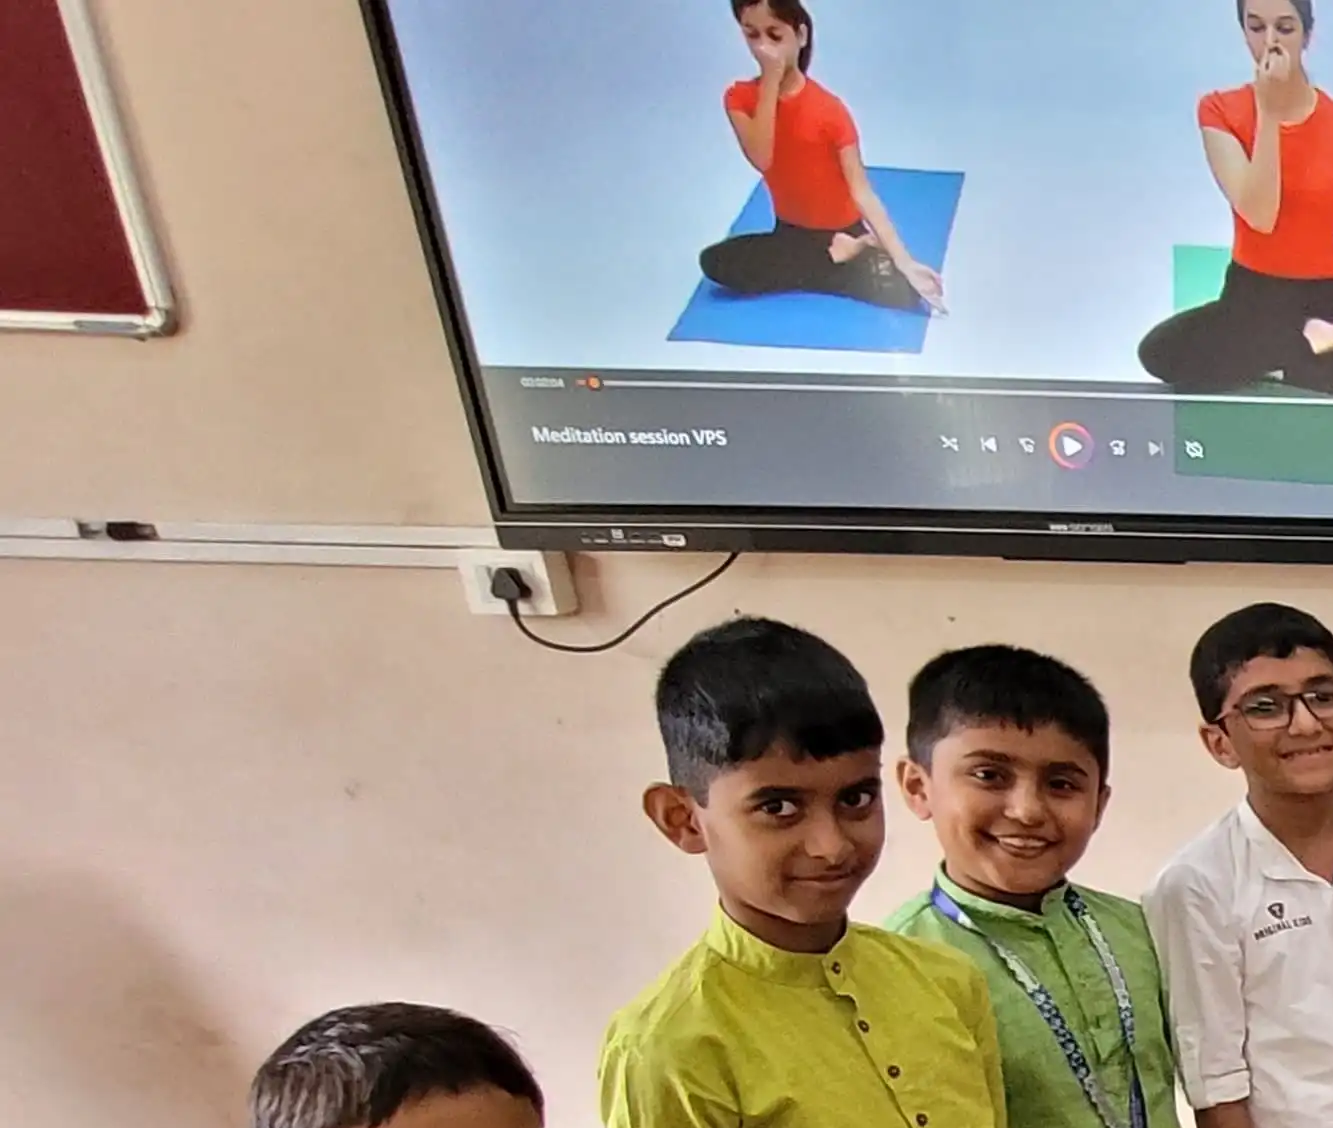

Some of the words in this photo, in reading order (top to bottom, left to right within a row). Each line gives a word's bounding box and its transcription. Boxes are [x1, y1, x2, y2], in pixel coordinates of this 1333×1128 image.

[531, 427, 626, 444] Meditation
[629, 429, 691, 446] session
[692, 430, 728, 446] VPS
